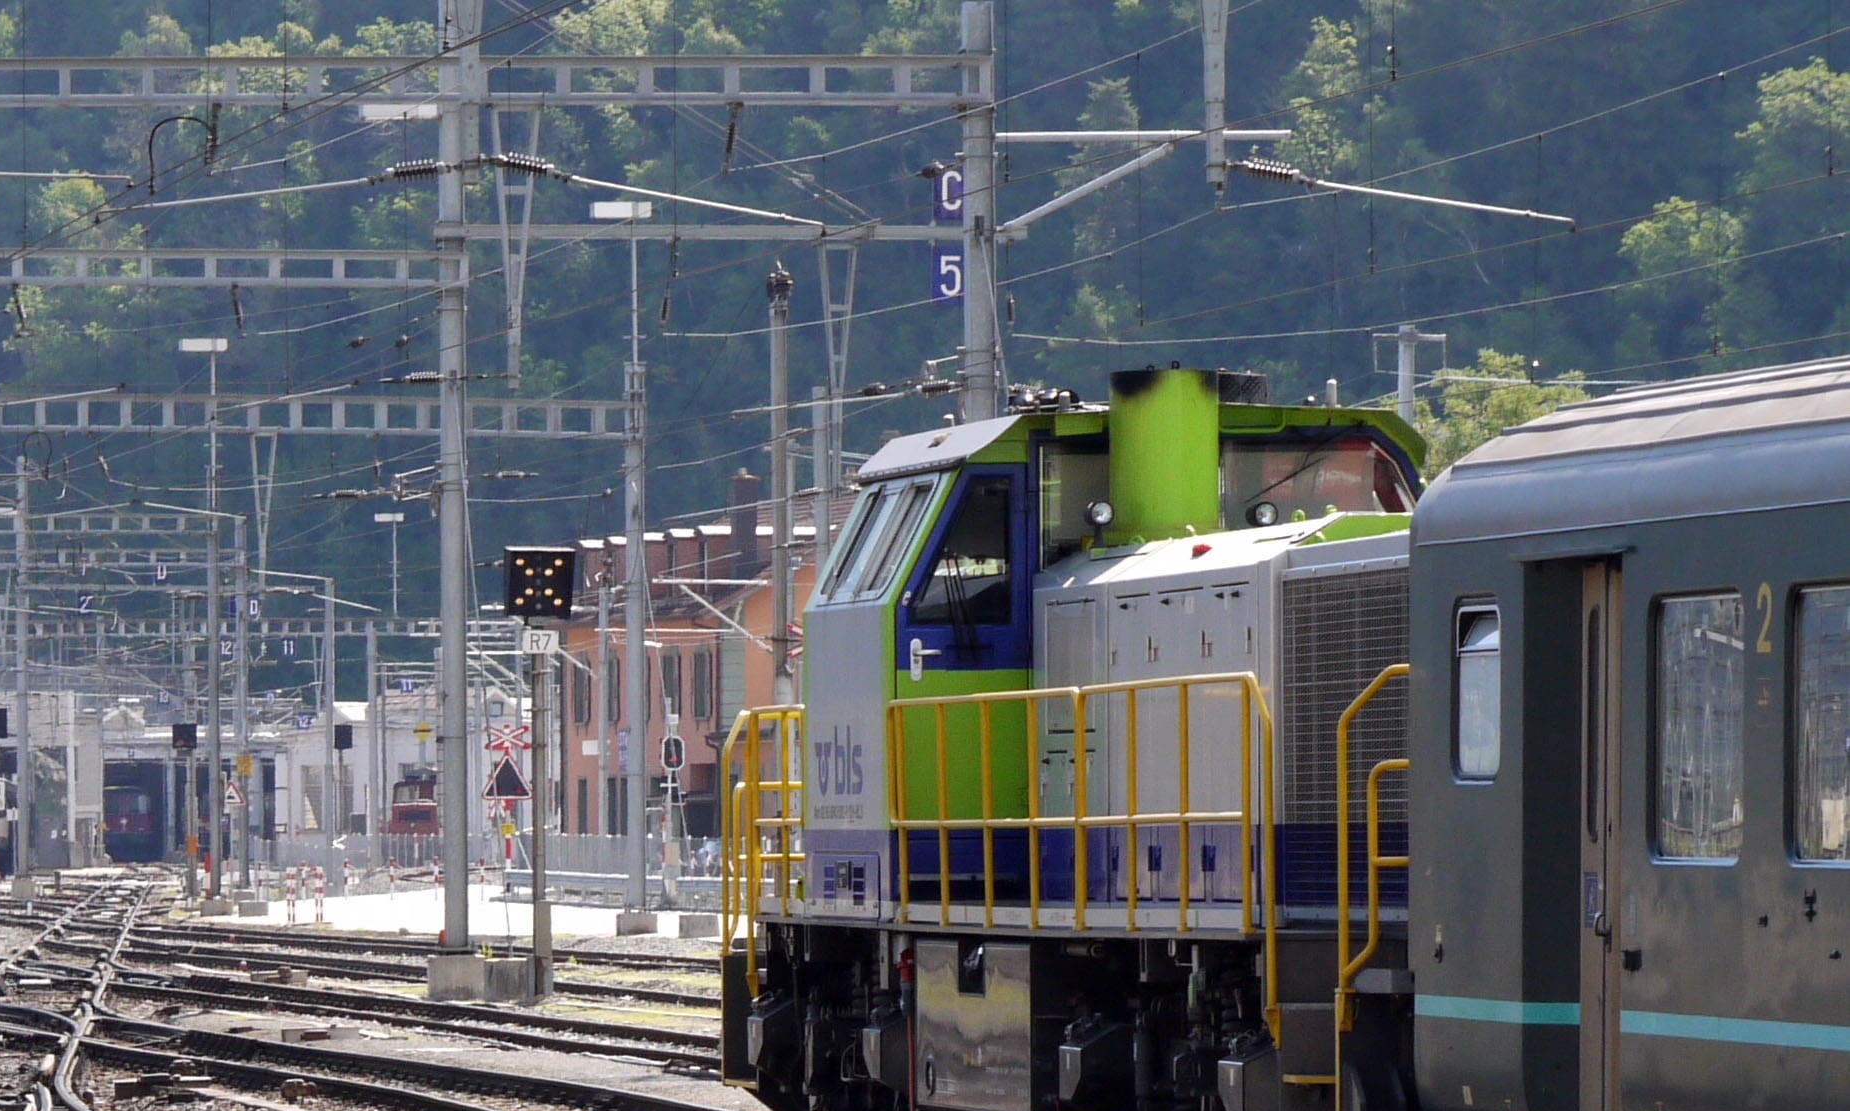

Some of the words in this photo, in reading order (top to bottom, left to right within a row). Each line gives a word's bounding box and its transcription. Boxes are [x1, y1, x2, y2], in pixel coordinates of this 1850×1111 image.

[941, 170, 963, 211] C
[940, 255, 962, 297] 5
[1756, 582, 1773, 653] 2
[283, 639, 294, 655] 11
[530, 633, 552, 651] R7
[834, 725, 863, 795] bls
